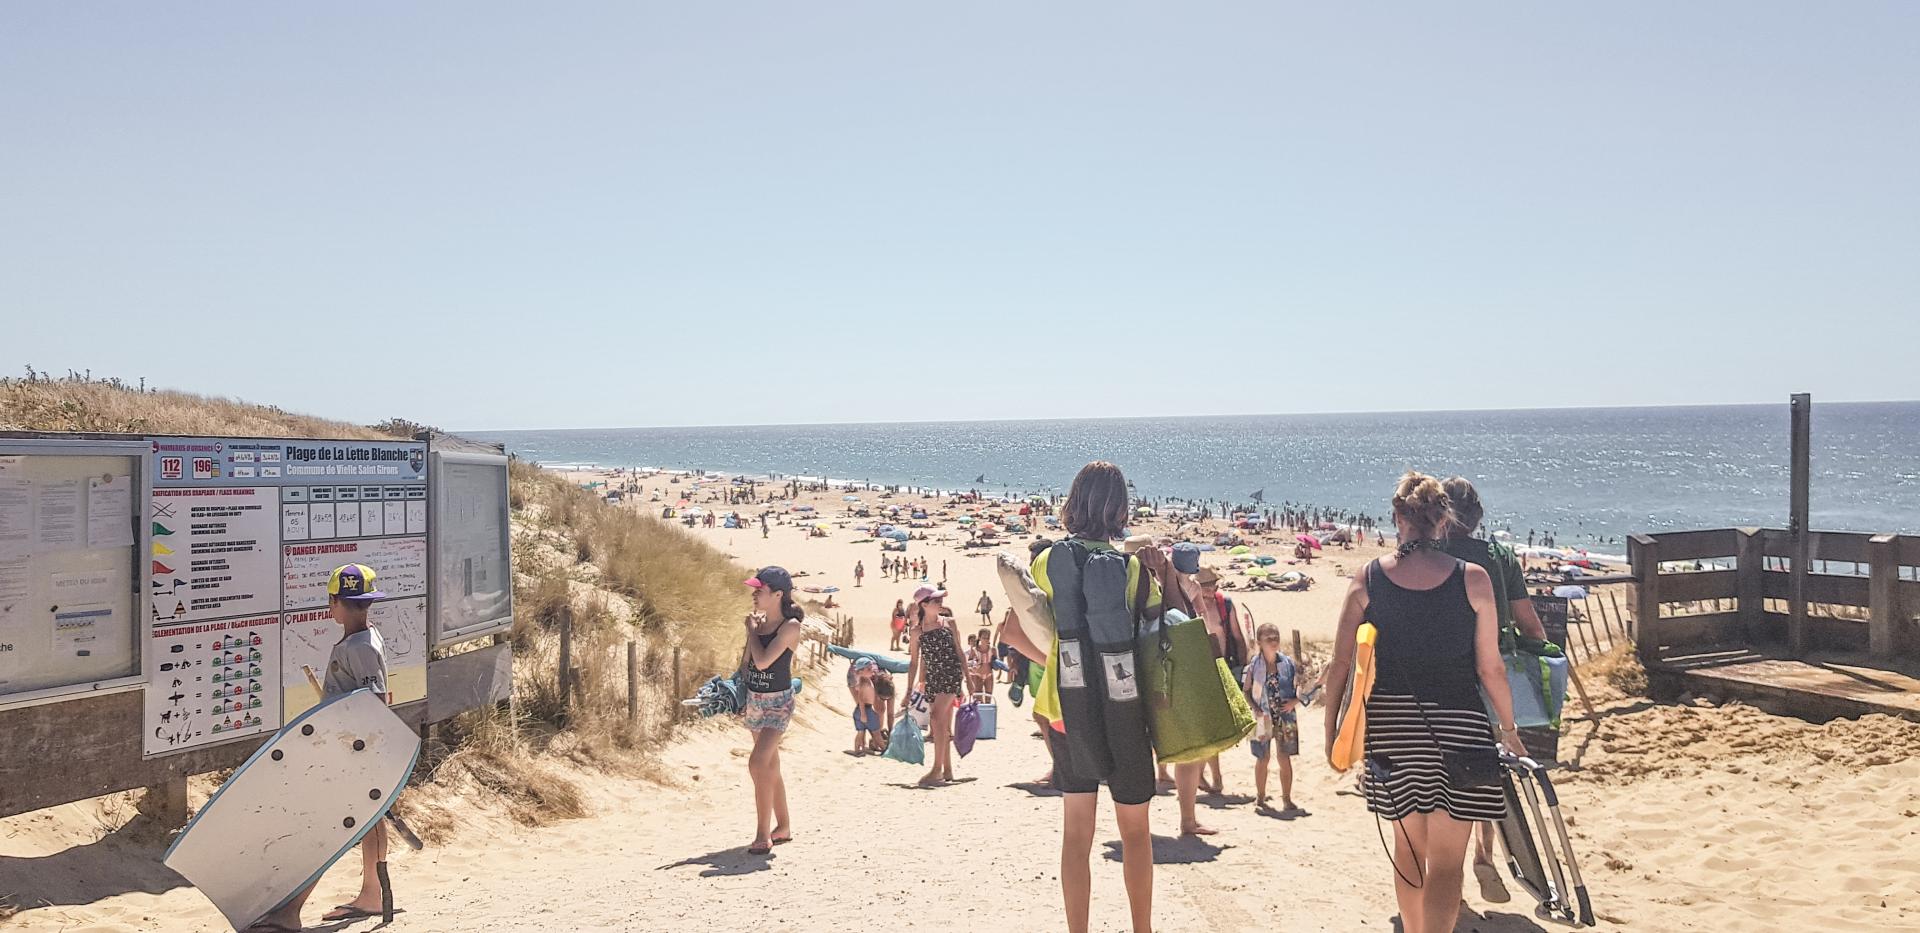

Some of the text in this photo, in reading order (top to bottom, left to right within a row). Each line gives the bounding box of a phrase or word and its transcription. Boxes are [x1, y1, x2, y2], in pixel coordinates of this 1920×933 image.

[286, 446, 316, 461] Plage
[319, 447, 331, 461] de
[334, 447, 343, 461] La
[346, 447, 370, 461] Lette
[372, 447, 409, 461] Blanche
[163, 459, 180, 471] 112
[194, 460, 211, 472] 196
[286, 464, 325, 475] Commune
[326, 465, 335, 475] de
[358, 465, 376, 475] Saint
[377, 465, 399, 475] Girons
[292, 543, 358, 555] DANGER PARTICULIERS
[343, 575, 360, 590] NY
[293, 611, 333, 623] PLAN DE PLAG
[152, 626, 194, 638] GLEMENTATION
[196, 625, 202, 633] DE
[203, 624, 209, 632] LA
[211, 623, 226, 631] PLAGE
[0, 642, 14, 651] he
